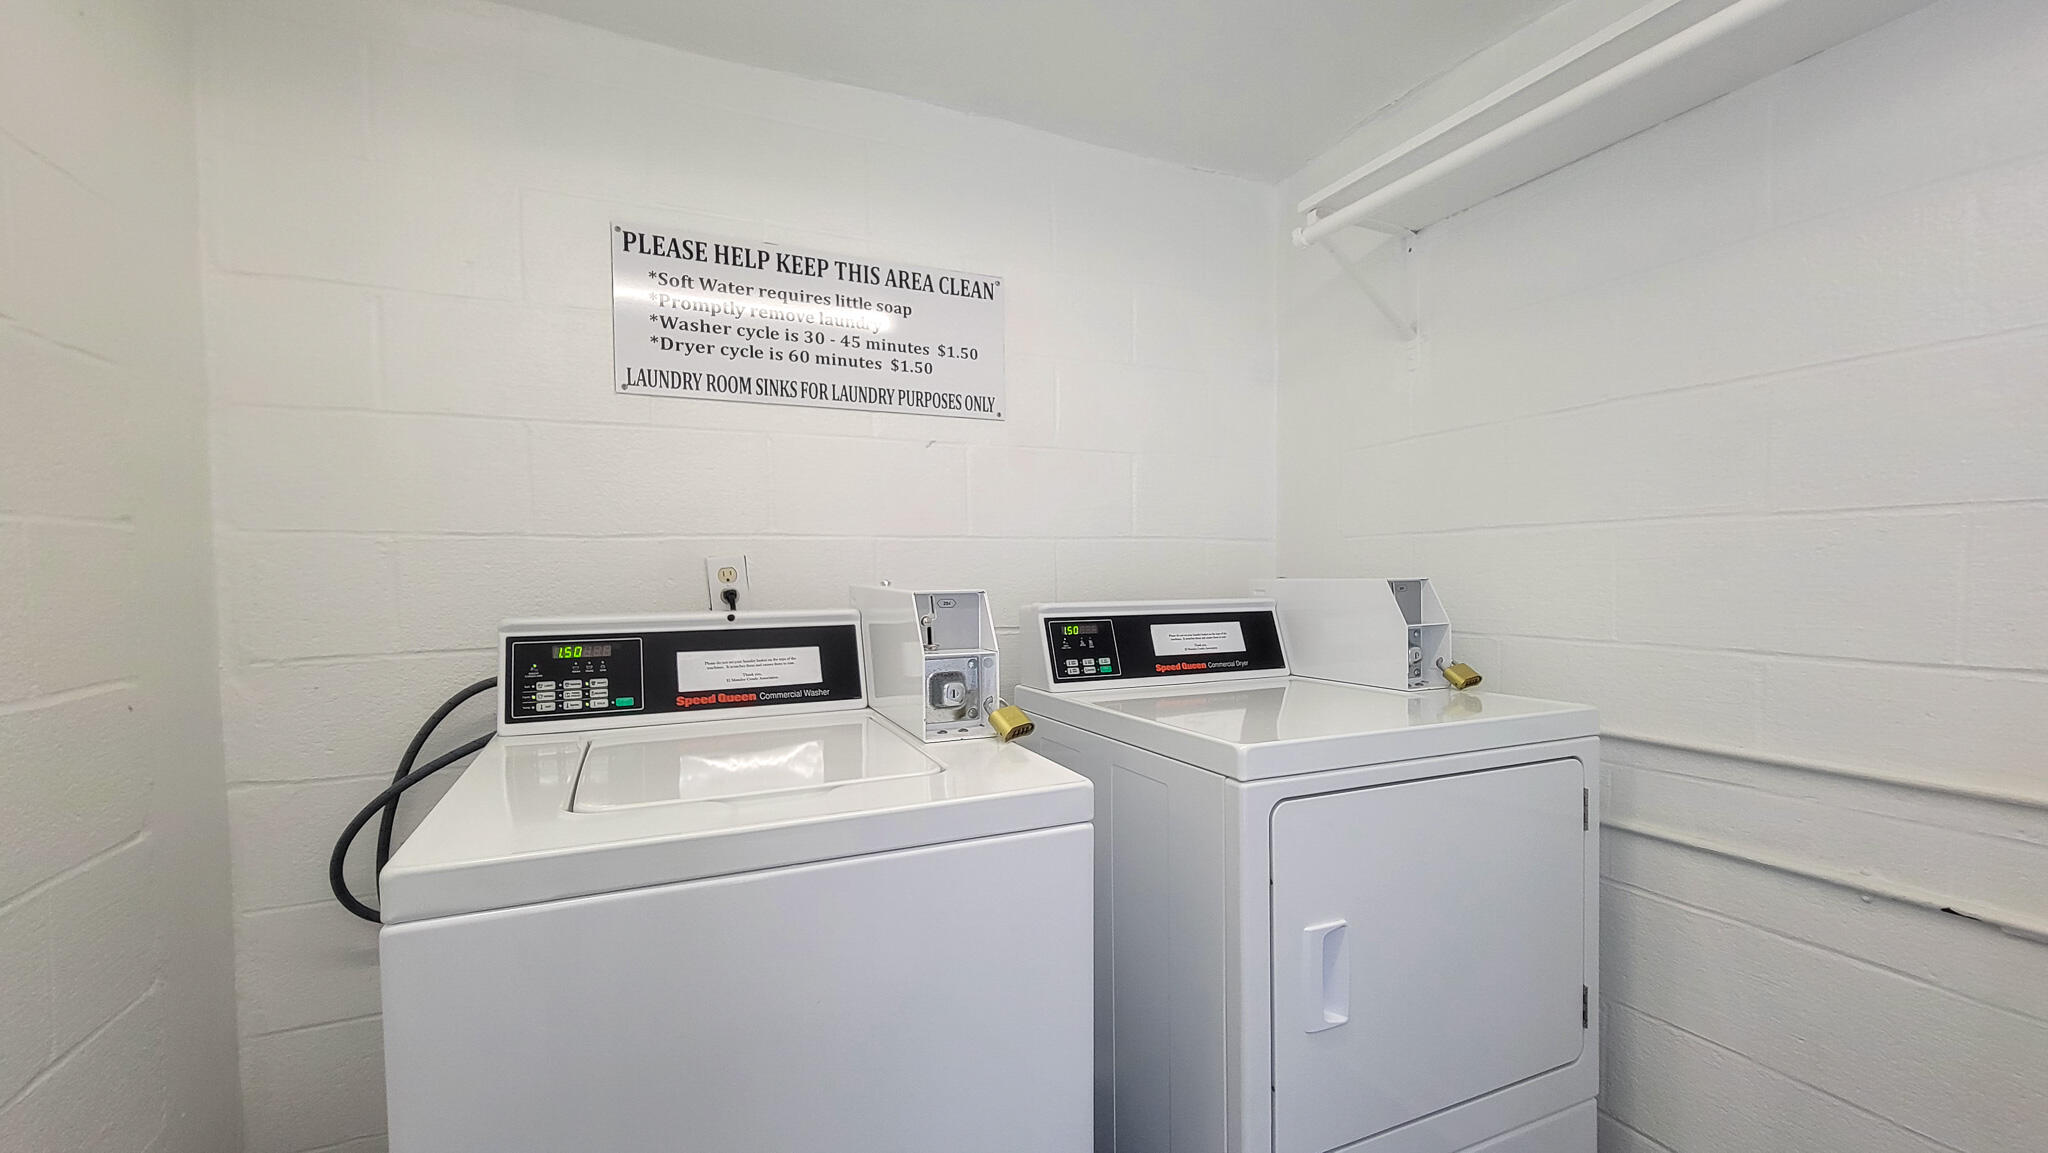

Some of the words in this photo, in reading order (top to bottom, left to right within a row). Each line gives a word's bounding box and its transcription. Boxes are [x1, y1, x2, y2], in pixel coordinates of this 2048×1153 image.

[622, 230, 708, 263] PLEASE
[713, 243, 770, 270] HELP
[776, 252, 829, 278] KEEP
[834, 261, 881, 285] THIS
[884, 269, 935, 293] AREA
[938, 276, 994, 301] CLEAN
[698, 277, 754, 296] Water
[758, 287, 831, 306] requires
[835, 294, 872, 311] little
[876, 302, 912, 318] soap
[750, 305, 815, 324] remove
[819, 313, 882, 334] laundry
[736, 326, 780, 341] cycle
[785, 328, 799, 342] is
[803, 330, 825, 345] 30
[840, 334, 861, 348] 45
[866, 339, 930, 356] minutes
[937, 344, 978, 361] $1.50
[720, 345, 764, 360] cycle
[769, 347, 784, 361] is
[788, 349, 809, 363] 60
[815, 353, 882, 370] minutes
[890, 358, 933, 375] $1.50
[626, 367, 703, 390] LAUNDRY
[706, 373, 753, 395] ROOM
[755, 378, 798, 398] SINKS
[800, 381, 829, 400] FOR
[831, 383, 896, 405] LAUNDRY
[898, 389, 963, 411] PURPOSES
[964, 395, 995, 413] ONLY
[1155, 663, 1181, 672] Speed
[1182, 662, 1207, 670] Queen
[675, 694, 717, 707] Speed
[718, 693, 757, 703] Queen
[759, 689, 802, 700] Commercial
[803, 688, 830, 697] Washer
